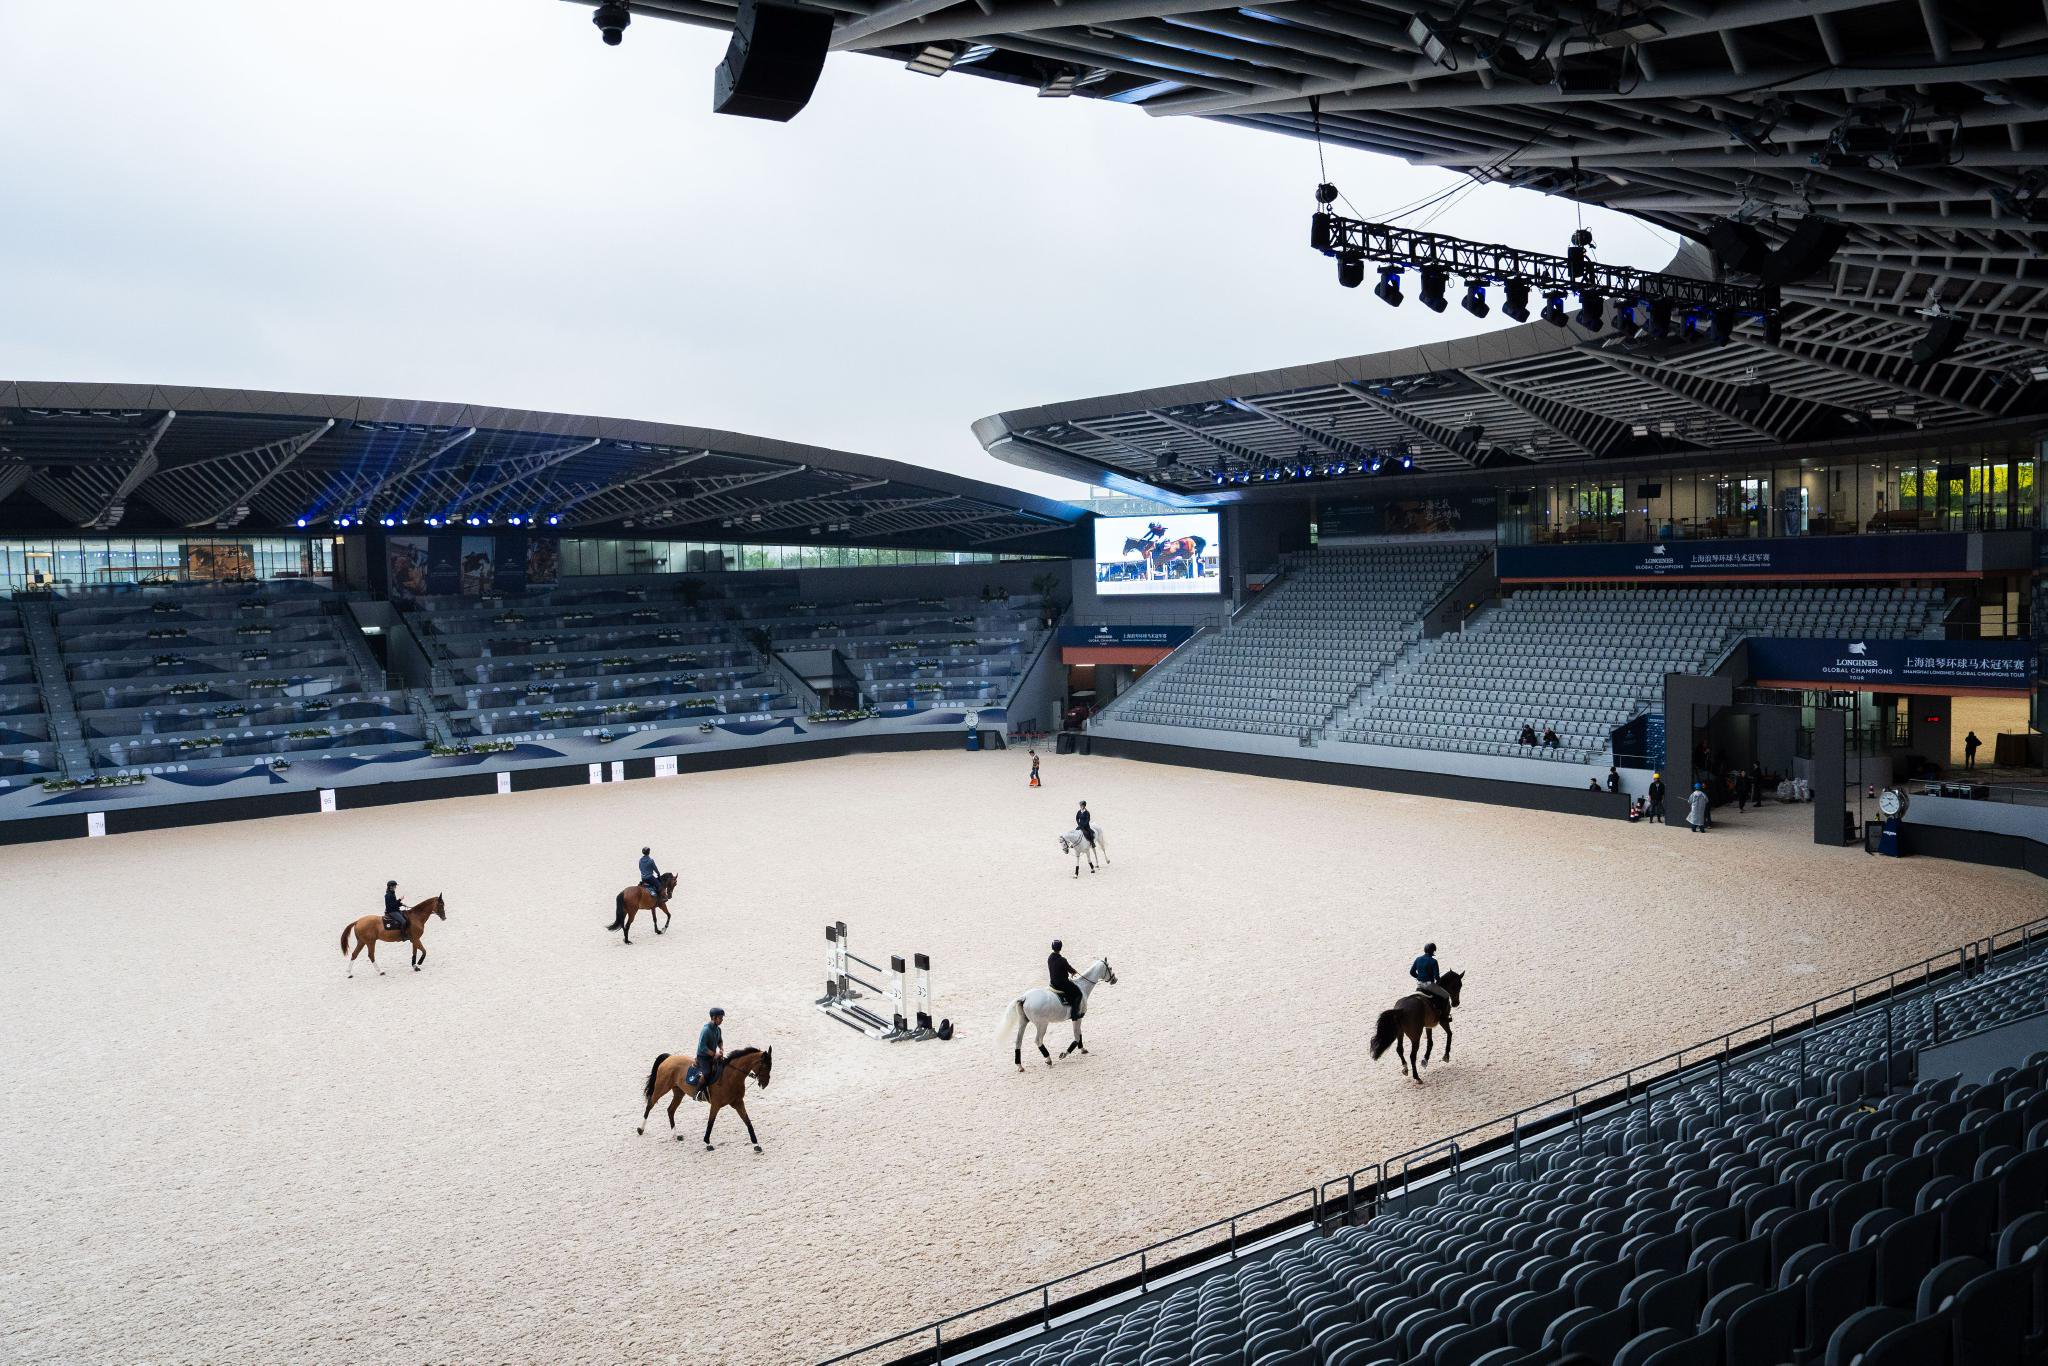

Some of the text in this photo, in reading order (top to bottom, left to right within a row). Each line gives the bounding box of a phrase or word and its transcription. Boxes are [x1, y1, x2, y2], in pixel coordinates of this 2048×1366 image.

[1836, 659, 1878, 667] LONGINES
[1904, 657, 2025, 671] 上海浪琴环球马术冠军赛
